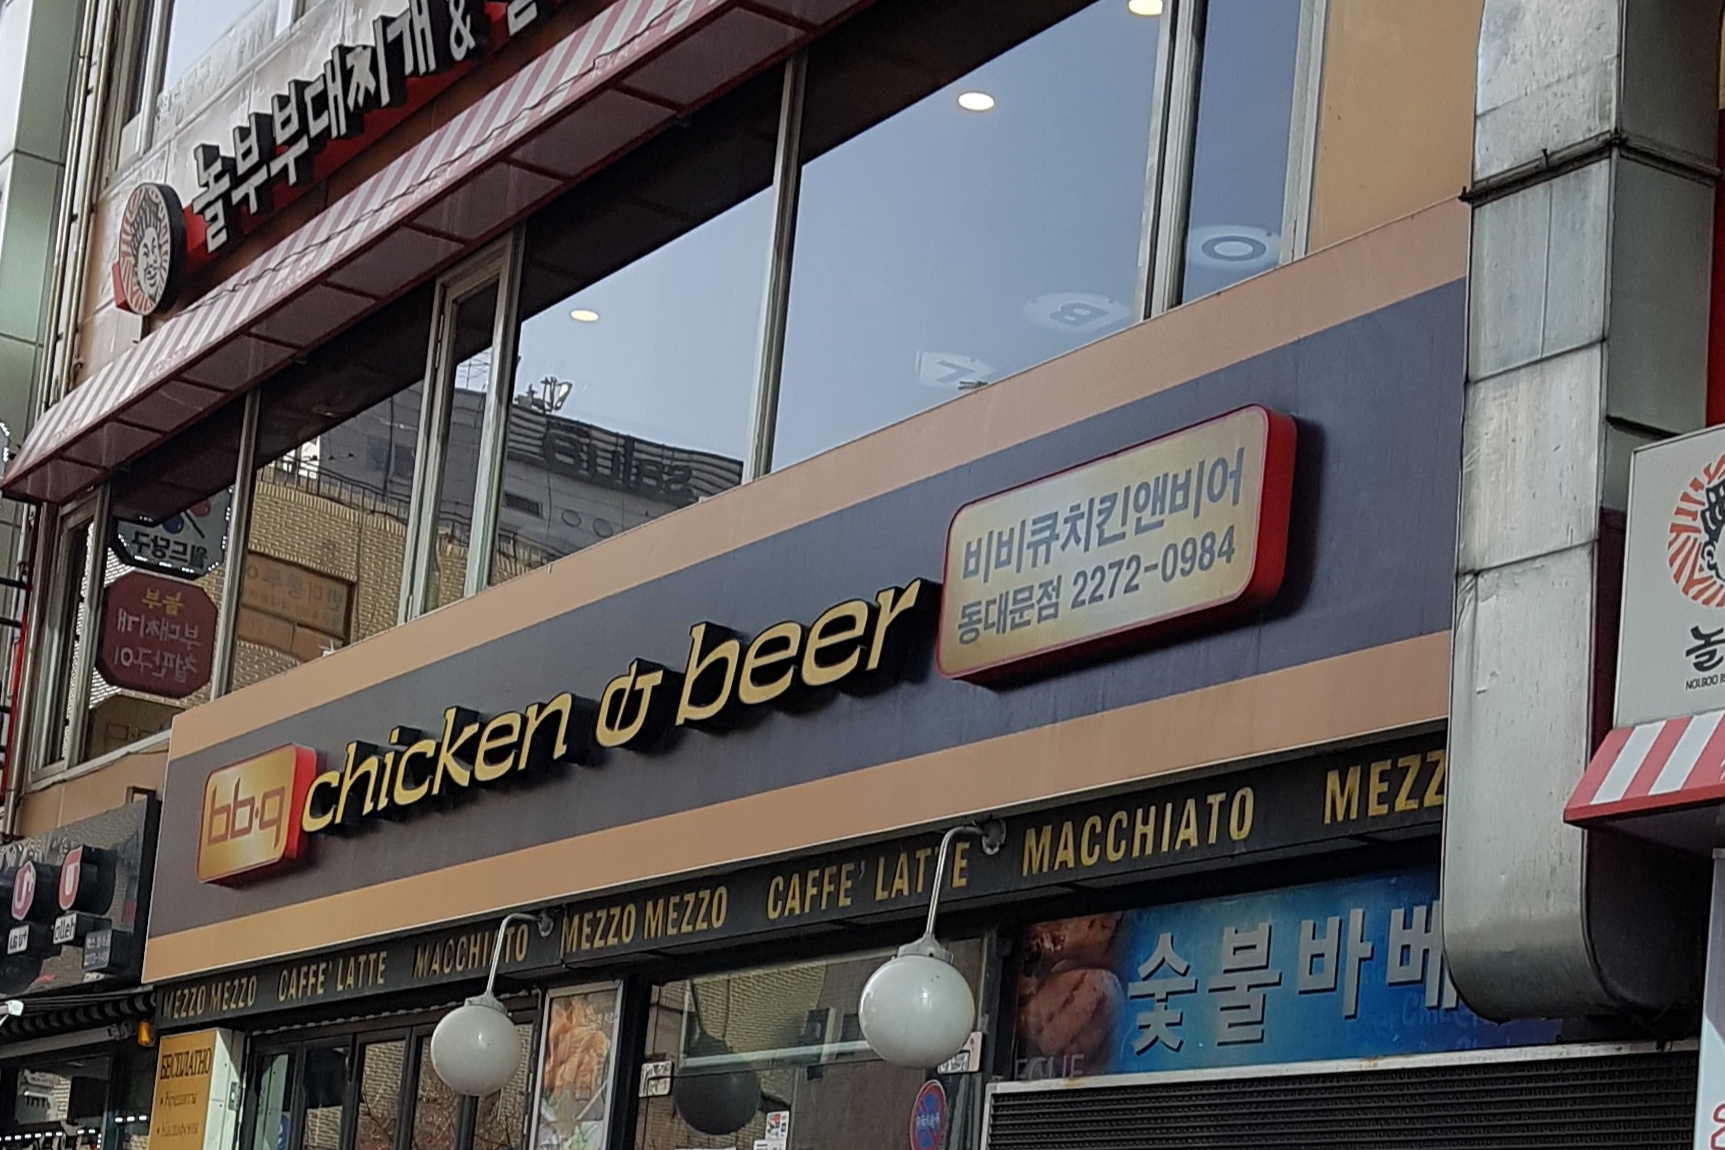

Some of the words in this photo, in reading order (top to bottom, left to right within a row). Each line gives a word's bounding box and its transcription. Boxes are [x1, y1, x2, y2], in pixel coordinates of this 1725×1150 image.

[962, 447, 1245, 584] 비비큐치킨앤비어
[957, 574, 1064, 647] 동대문점
[1070, 525, 1236, 612] 2272-0984
[301, 692, 573, 833] chicken
[676, 578, 920, 727] beer
[1323, 749, 1446, 825] MEZZ
[875, 841, 970, 901] LATE
[1022, 787, 1255, 877] MACCHIATO
[561, 904, 636, 953] MEZZO
[643, 886, 728, 939] MEZZO
[161, 985, 206, 1020] MEZZO
[209, 975, 258, 1011] MEZZO
[336, 951, 388, 989] LATTE
[1128, 903, 1459, 1055] 숯불바베
